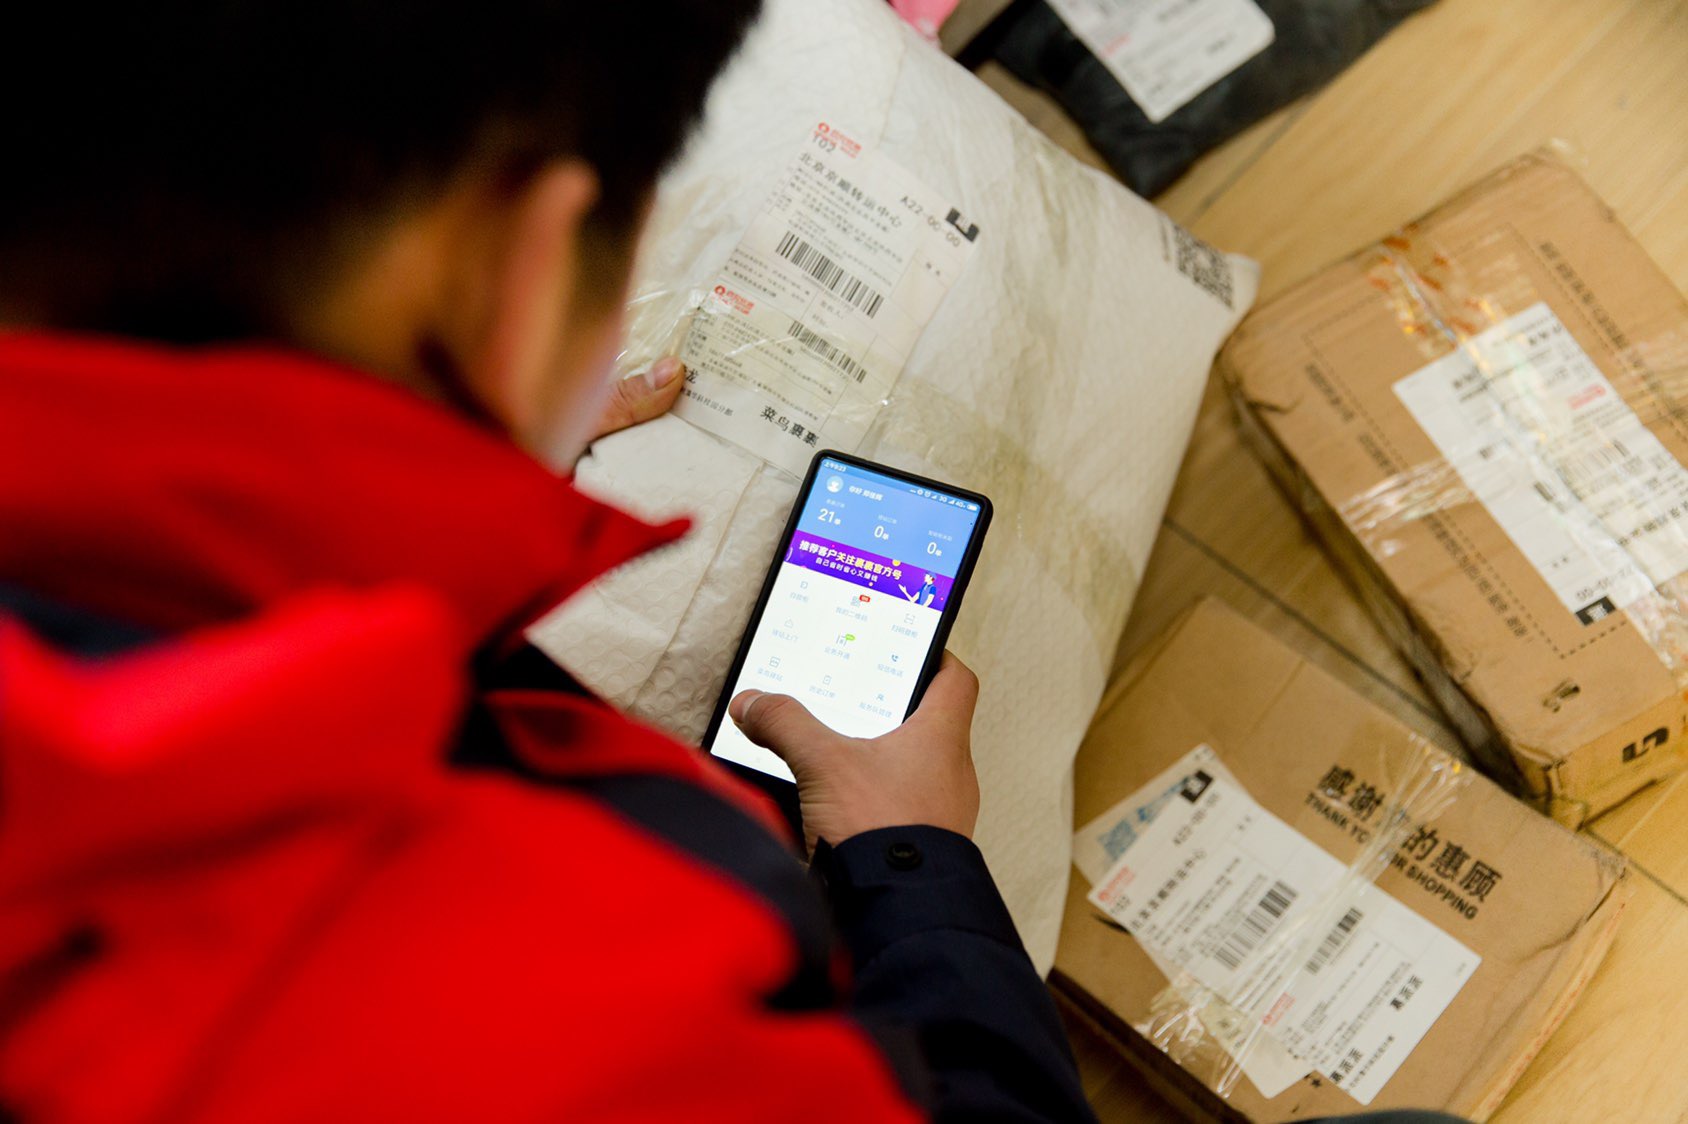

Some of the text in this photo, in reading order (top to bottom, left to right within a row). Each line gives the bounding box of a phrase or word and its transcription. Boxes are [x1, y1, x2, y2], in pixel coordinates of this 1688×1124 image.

[760, 405, 820, 448] 菜鸟裹裹
[798, 539, 902, 581] 推荐客户关注裹裹官方号
[815, 558, 878, 583] 自己省时省心又赚钱
[1318, 763, 1503, 903] 感谢的惠顾
[1405, 863, 1479, 920] SHOPPING
